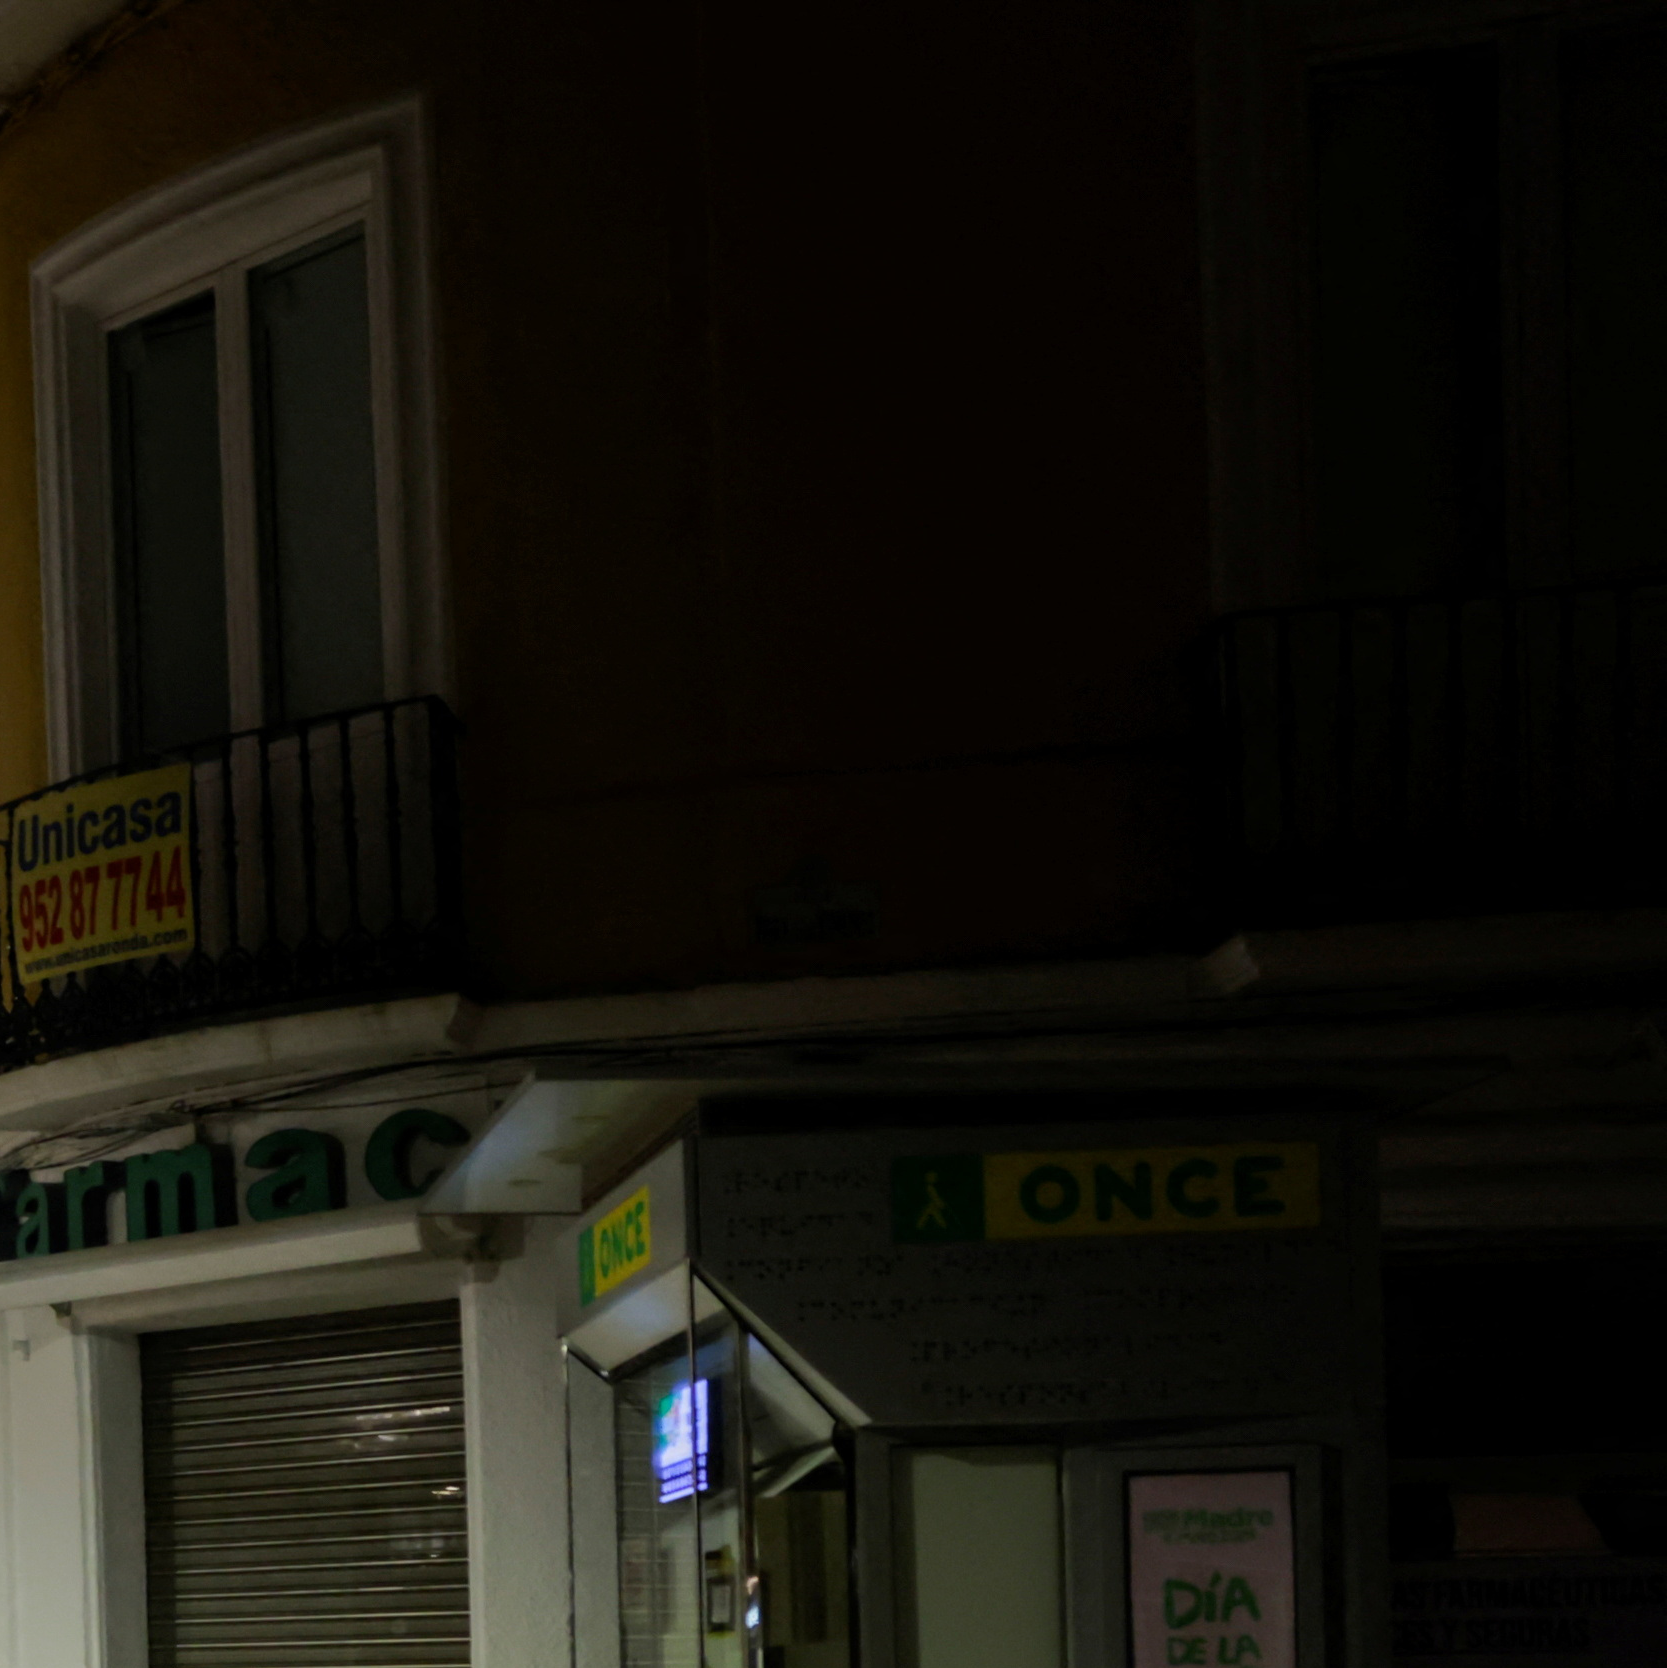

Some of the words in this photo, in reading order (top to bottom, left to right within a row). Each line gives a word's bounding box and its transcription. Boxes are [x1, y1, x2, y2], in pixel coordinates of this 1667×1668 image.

[18, 792, 182, 871] Unicasa
[19, 875, 65, 952] 952
[69, 866, 101, 940] 87
[106, 856, 142, 931] 77
[145, 846, 186, 923] 44
[1019, 1156, 1285, 1204] ONCE
[599, 1200, 646, 1279] ONCE
[1163, 1570, 1262, 1629] DÍA
[1167, 1636, 1207, 1666] DE
[1217, 1634, 1263, 1665] LA
